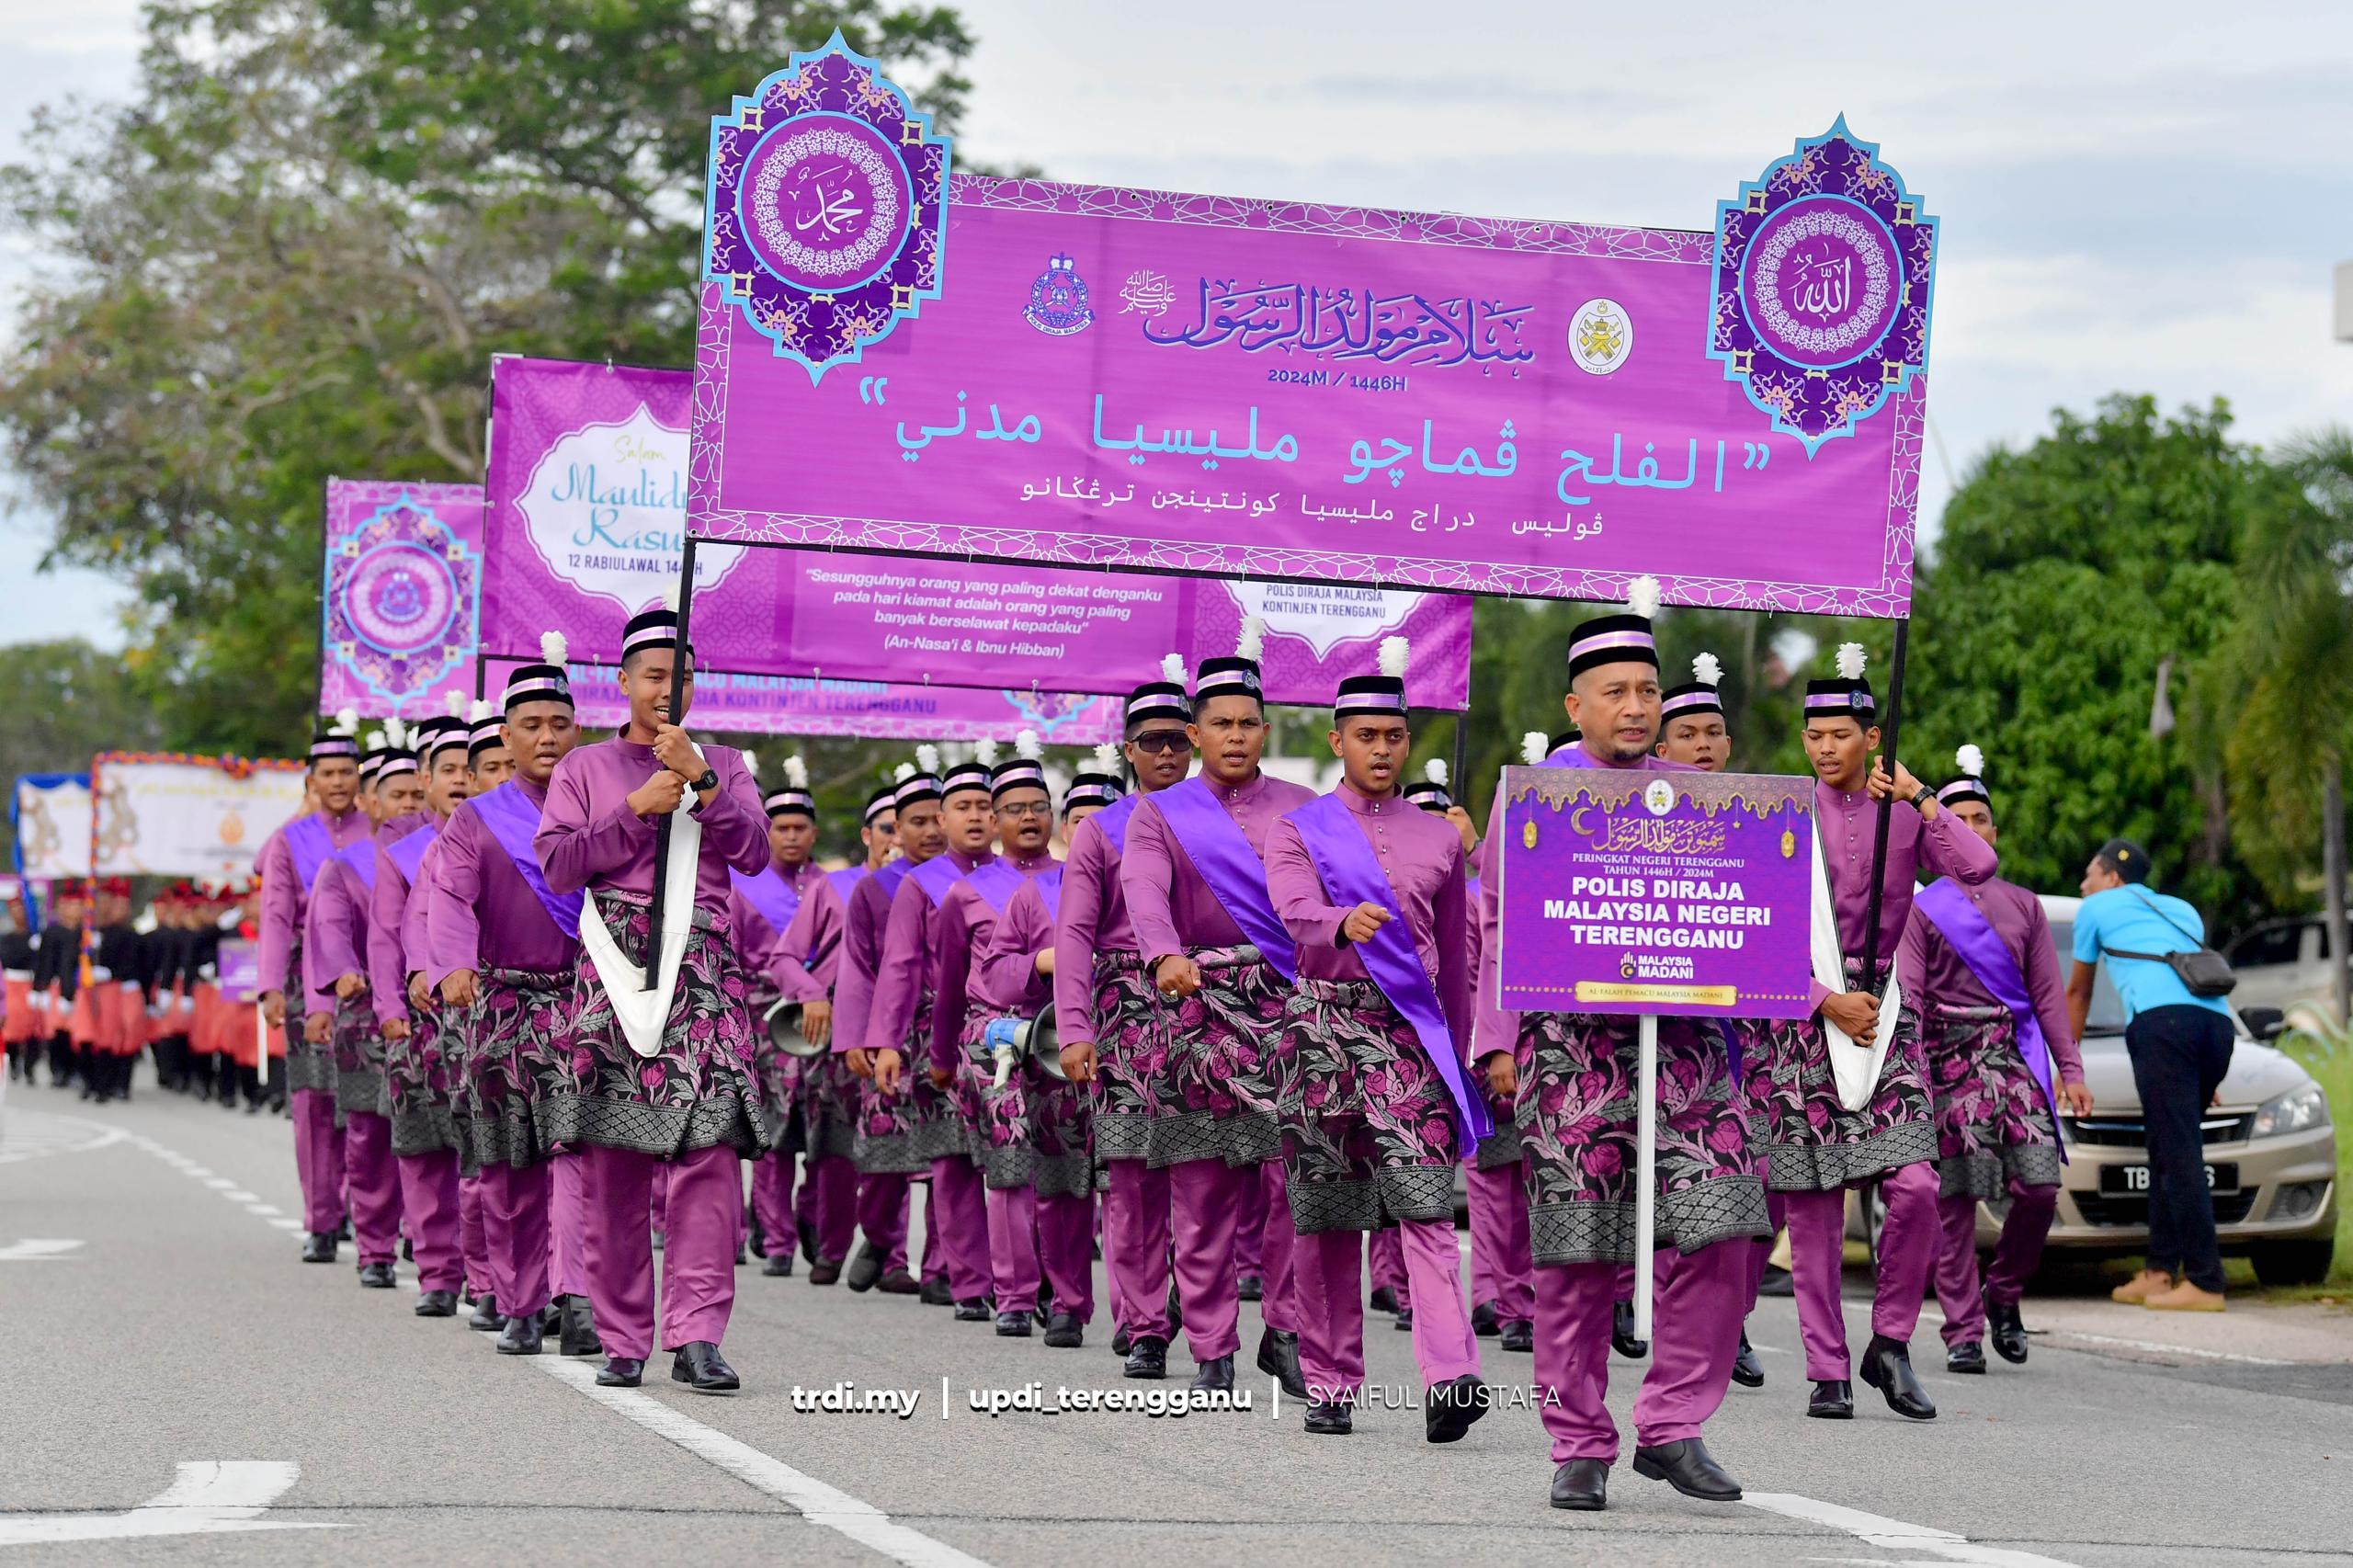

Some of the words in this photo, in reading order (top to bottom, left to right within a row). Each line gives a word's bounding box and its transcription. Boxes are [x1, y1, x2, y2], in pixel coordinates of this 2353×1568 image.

[1268, 369, 1329, 386] 2024M
[1350, 376, 1408, 392] 1446H
[551, 462, 687, 509] Maulid
[573, 507, 685, 551] Rasu
[568, 554, 581, 567] 12
[585, 555, 661, 573] RABIULAWAL
[666, 560, 703, 575] 14H
[919, 577, 961, 593] orang
[963, 581, 999, 596] yang
[1001, 582, 1045, 597] paling
[1049, 584, 1089, 597] dekat
[1092, 586, 1163, 603] denganku
[1267, 585, 1295, 597] POLIS
[1298, 586, 1332, 599] DIRAJA
[1335, 588, 1383, 602] MALAYSIA
[834, 591, 870, 604] pada
[873, 591, 901, 605] hari
[904, 594, 952, 608] kiamat
[954, 597, 1002, 611] adalah
[1005, 601, 1047, 615] orang
[1049, 604, 1086, 619] yang
[1087, 605, 1131, 621] paling
[1262, 600, 1317, 615] KONTINJEN
[1320, 604, 1385, 619] TERENGGANU
[874, 610, 926, 627] banyak
[928, 613, 1009, 631] berselawat
[961, 640, 972, 653] &
[975, 640, 1006, 653] Ibnu
[1009, 642, 1064, 659] Hibban)
[1573, 853, 1631, 864] PERINGKAT
[1632, 856, 1671, 866] NEGERI
[1674, 857, 1745, 868] TERENGGANU
[1603, 865, 1641, 875] TAHUN
[1643, 866, 1673, 876] 1446H
[1683, 868, 1714, 878] 2024M
[1572, 876, 1646, 898] POLIS
[1654, 879, 1745, 901] DIRAJA
[1543, 900, 1671, 922] MALAYSIA
[1677, 903, 1771, 926] NEGERI
[1569, 925, 1745, 949] TERENGGANU
[1638, 955, 1694, 966] MALAYSIA
[1638, 966, 1694, 979] MADANI
